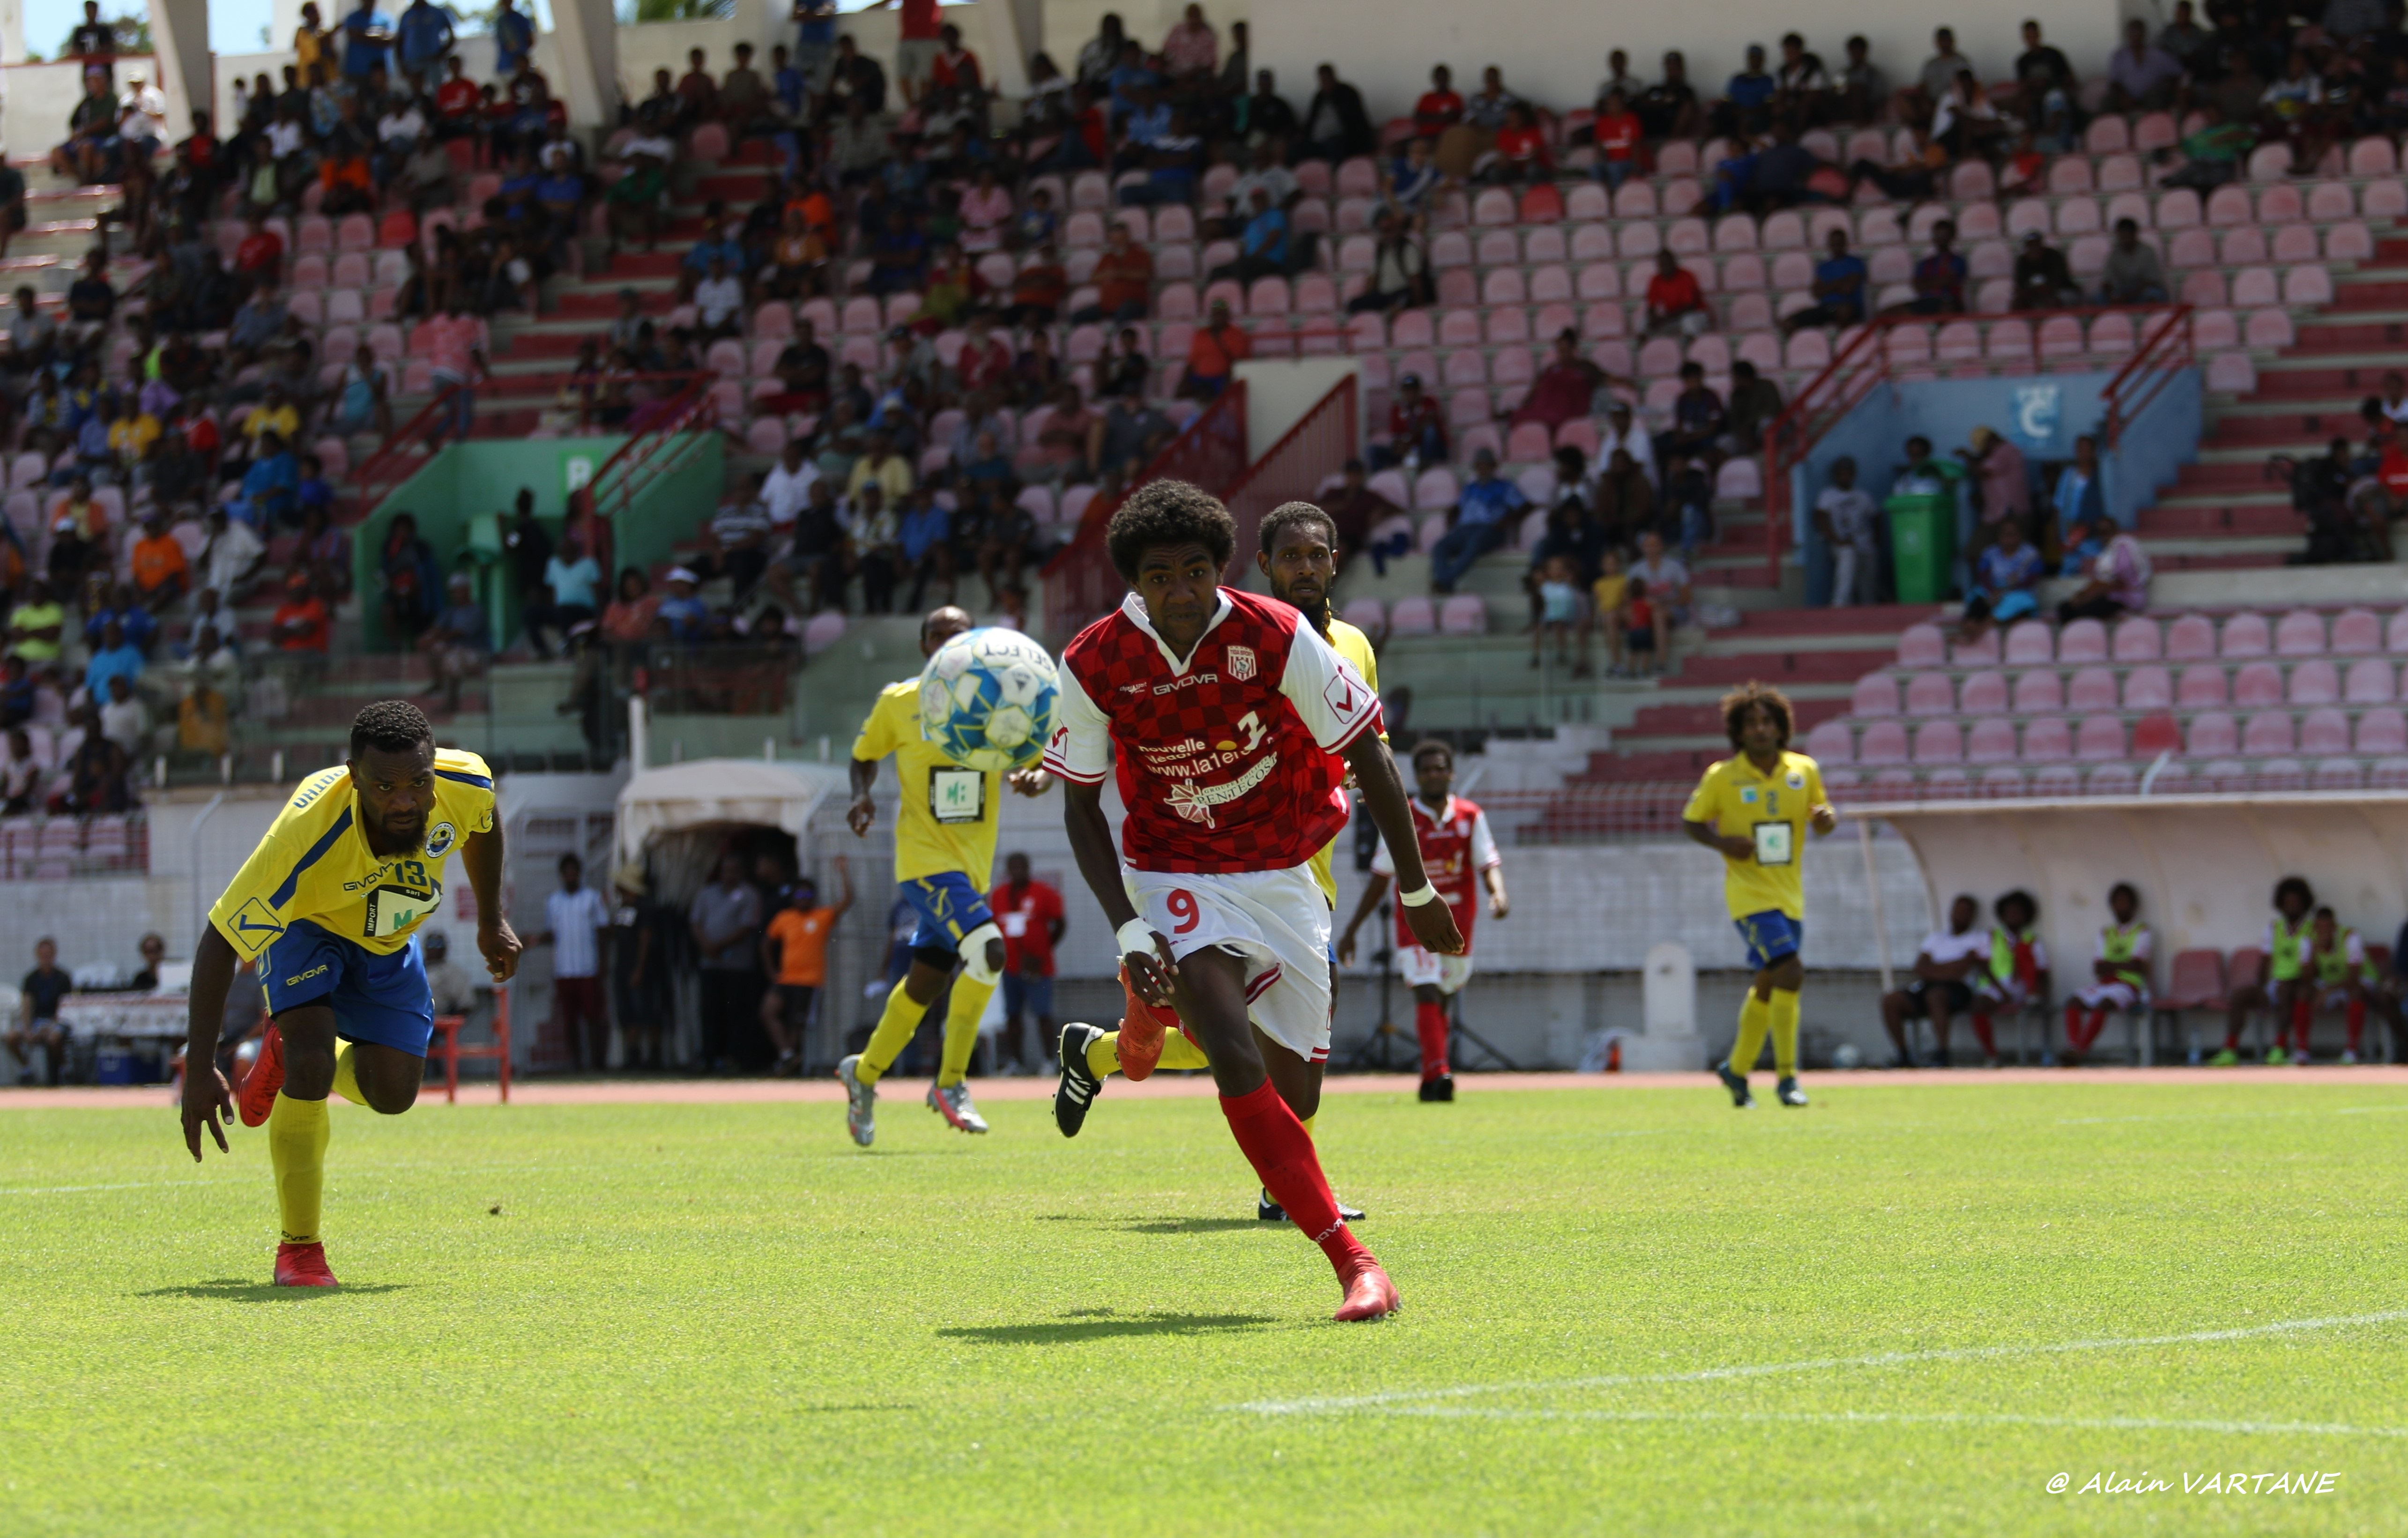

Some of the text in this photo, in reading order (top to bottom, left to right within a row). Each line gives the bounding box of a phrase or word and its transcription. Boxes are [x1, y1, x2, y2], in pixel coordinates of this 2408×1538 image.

[984, 642, 1052, 672] SELECT
[1153, 674, 1218, 695] GIVOVA
[1138, 738, 1206, 753] nouvelle
[1204, 782, 1236, 795] GROUPE
[395, 860, 427, 887] 13
[367, 903, 376, 931] IMPORT
[1167, 889, 1200, 934] 9
[286, 964, 329, 986] GIVOVA
